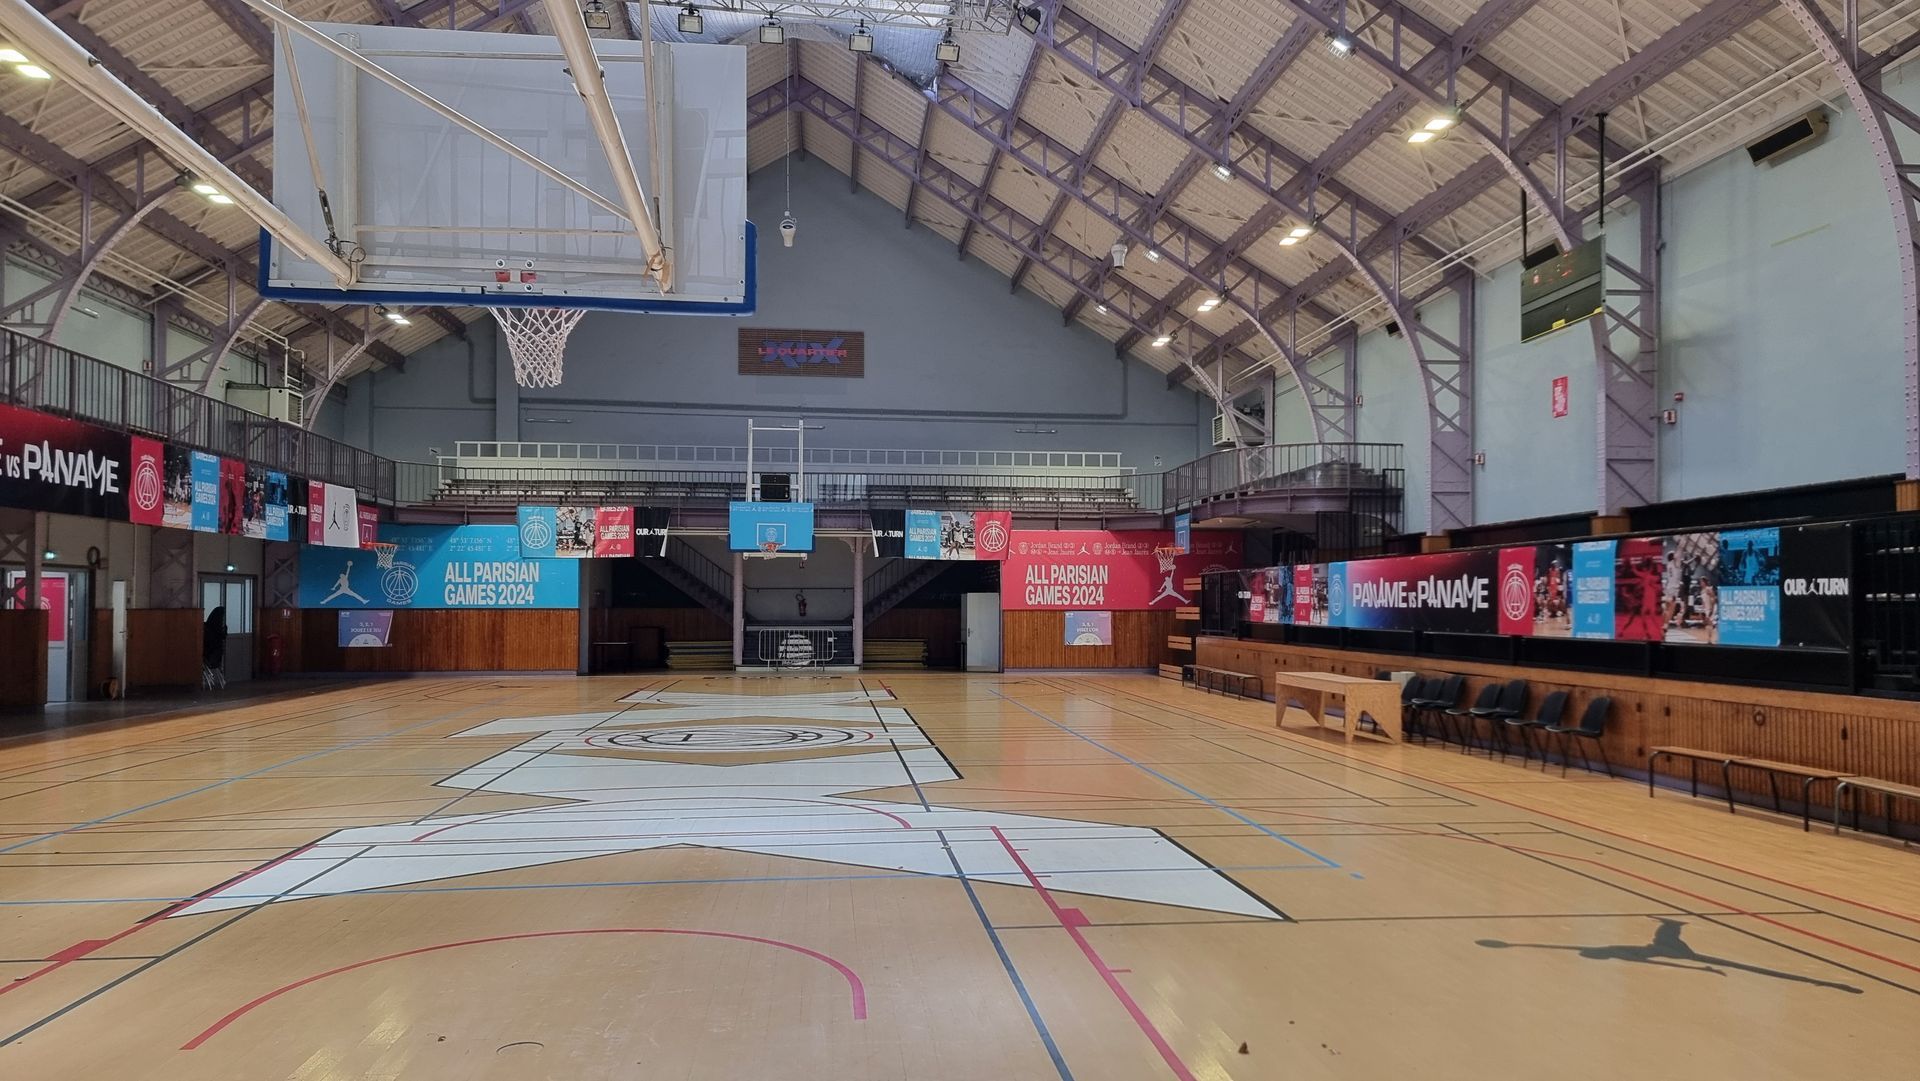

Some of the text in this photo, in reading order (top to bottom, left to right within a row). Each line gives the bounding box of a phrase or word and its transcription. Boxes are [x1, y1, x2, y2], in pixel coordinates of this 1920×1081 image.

[758, 347, 848, 357] LE QUARTIER
[23, 440, 119, 496] PANAME
[636, 528, 649, 536] OUR
[888, 530, 904, 538] TURN
[445, 562, 540, 583] ALL PARISIAN
[1025, 564, 1108, 585] ALL PARISIAN
[445, 584, 535, 605] GAMES 2024
[1025, 585, 1104, 605] GAMES 2024
[1352, 577, 1408, 609] PANAME
[1417, 573, 1489, 613] PANAME
[1784, 578, 1849, 595] OUR TURN
